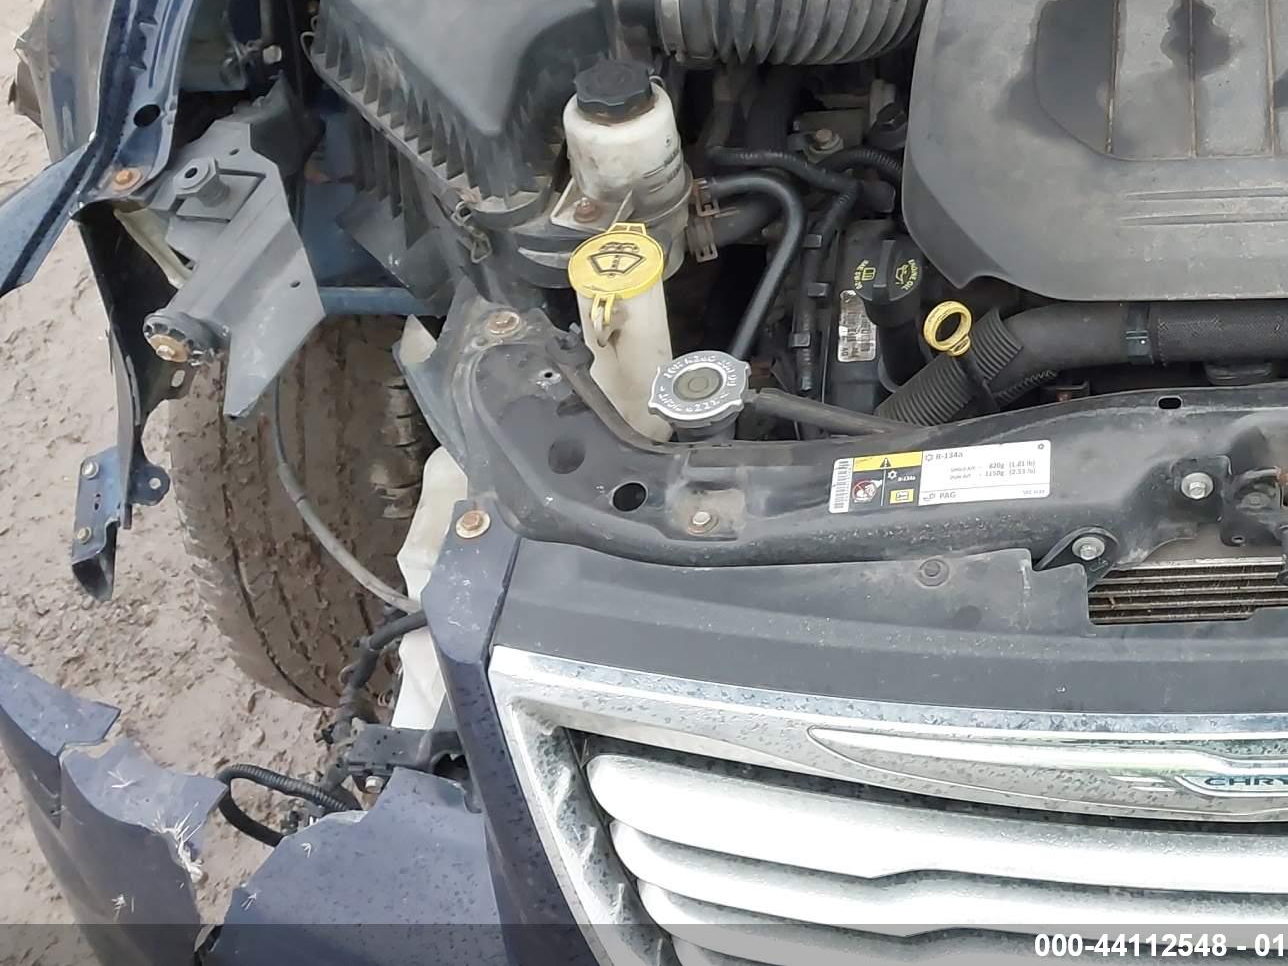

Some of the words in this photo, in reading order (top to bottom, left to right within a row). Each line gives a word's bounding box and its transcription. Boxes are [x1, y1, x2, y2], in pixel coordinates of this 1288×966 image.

[901, 278, 914, 290] OIL
[935, 451, 964, 461] R-134a
[938, 491, 957, 500] PAG
